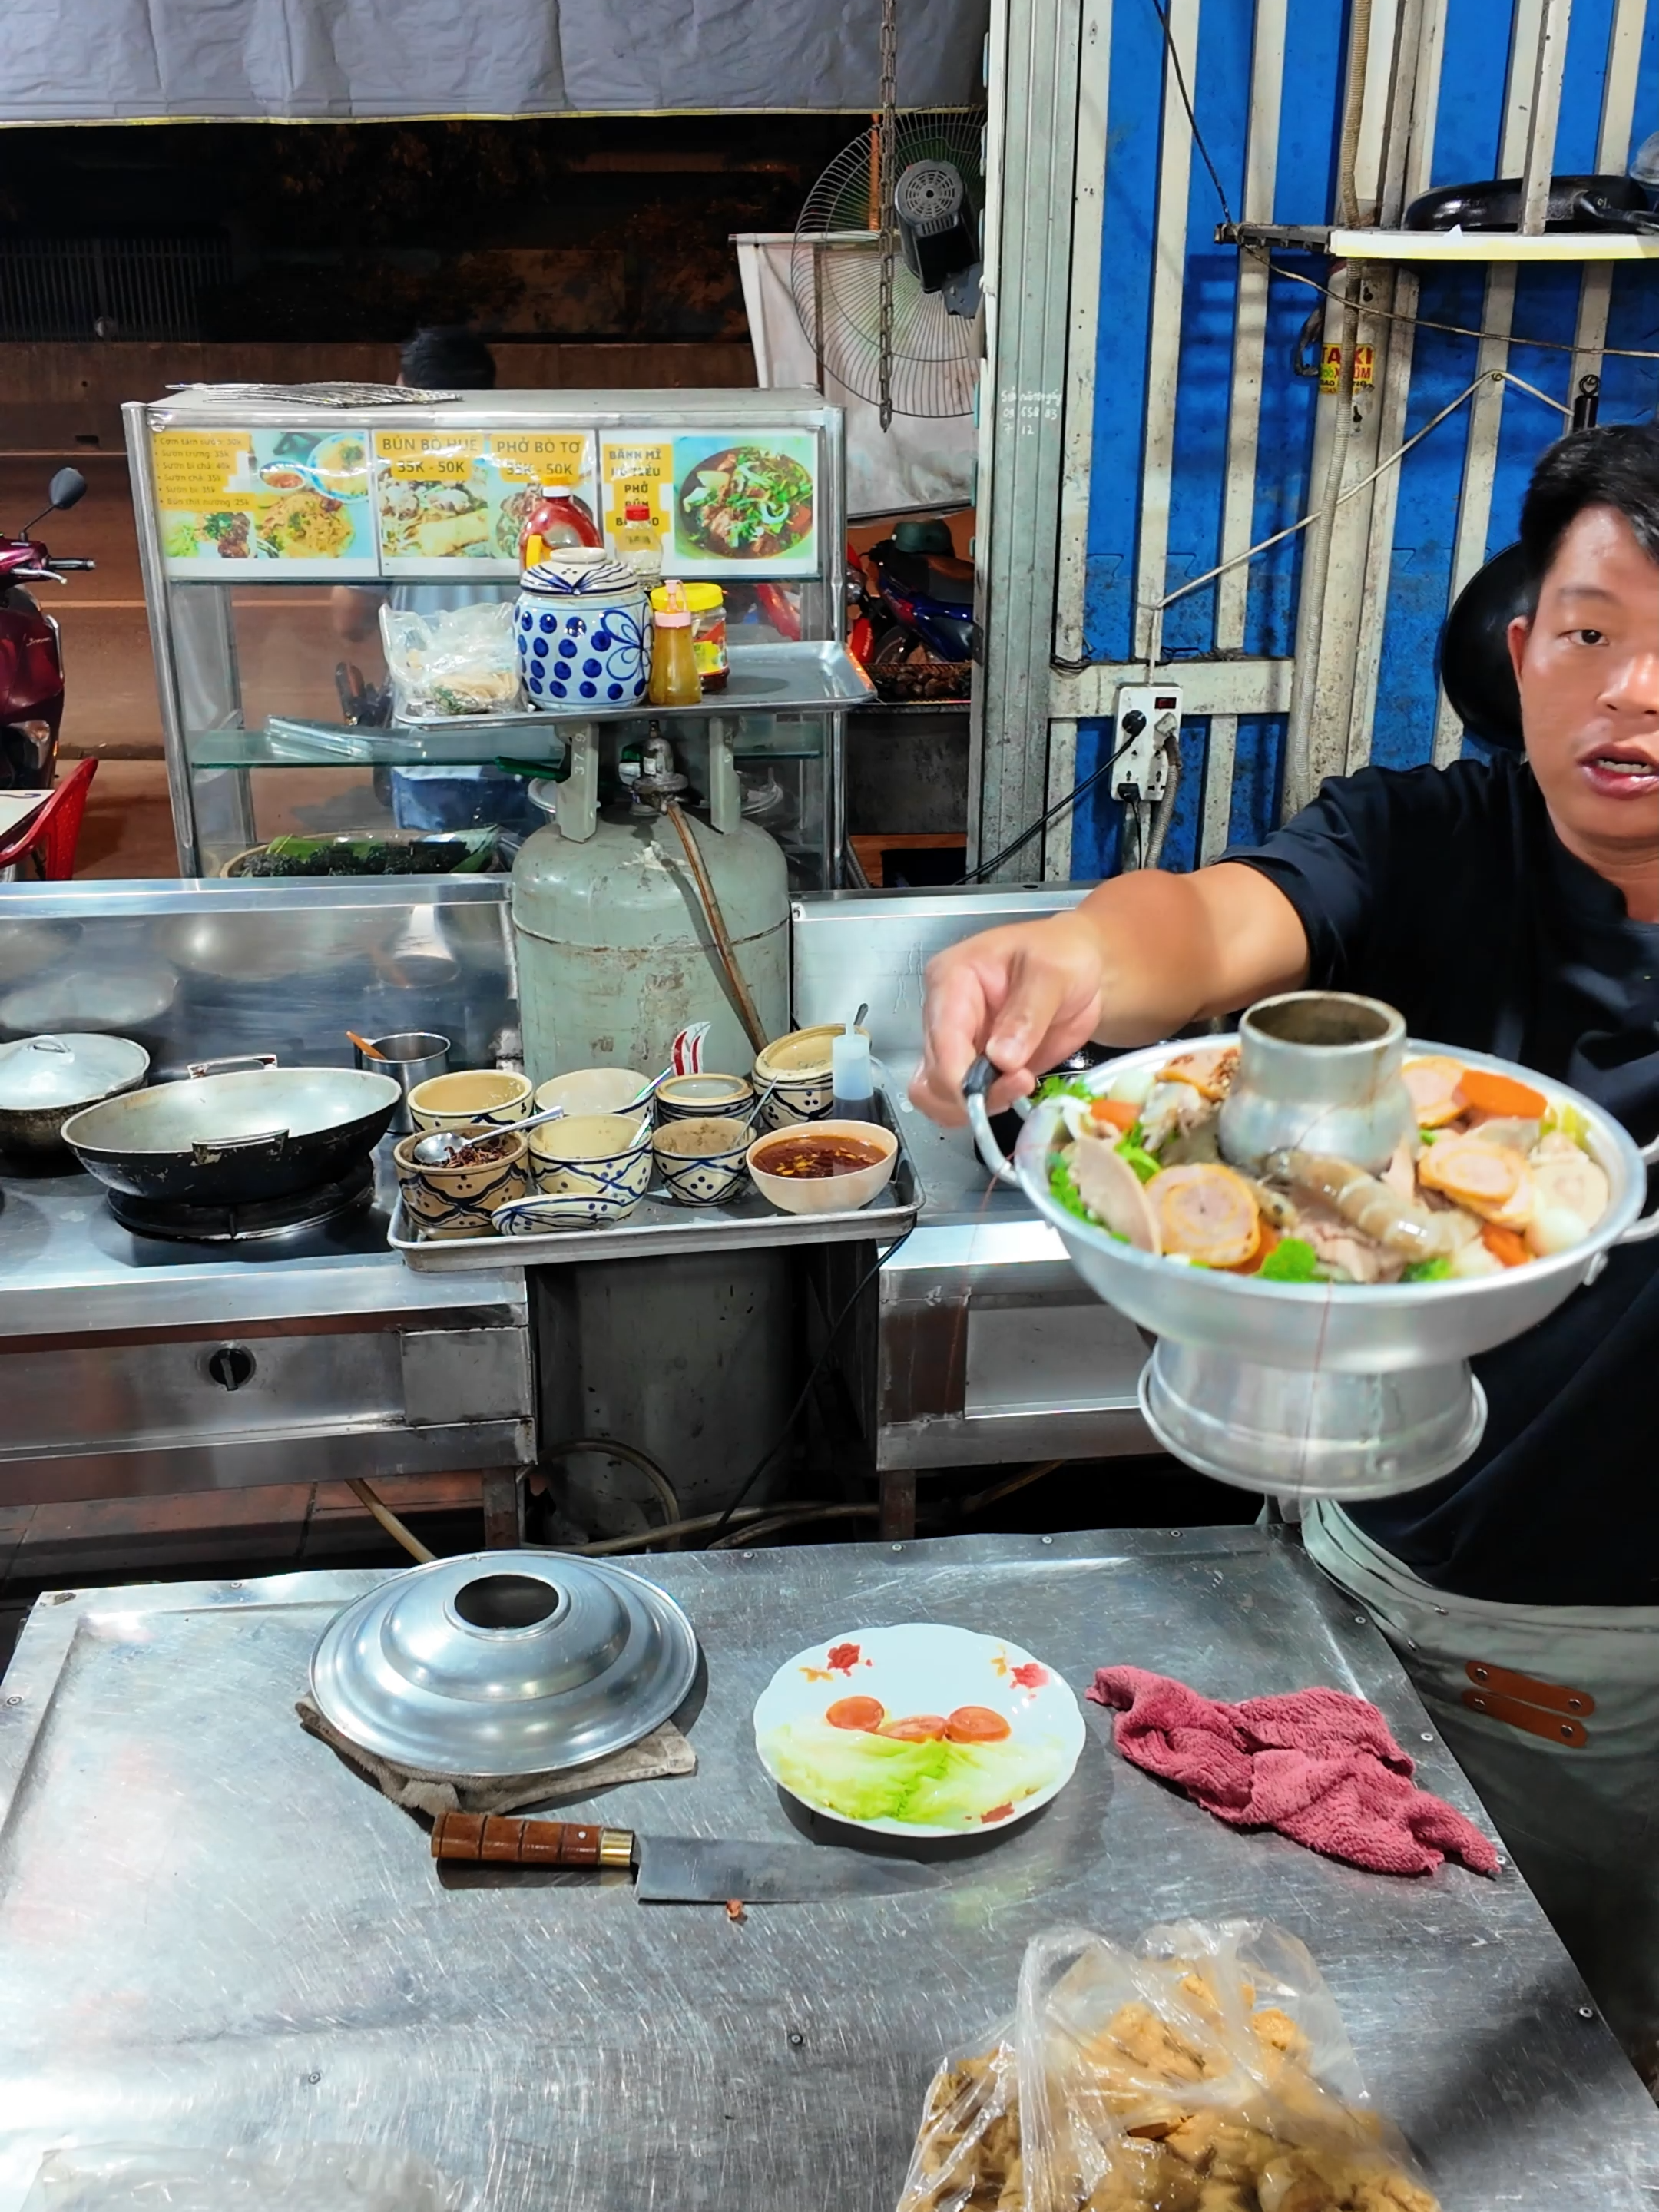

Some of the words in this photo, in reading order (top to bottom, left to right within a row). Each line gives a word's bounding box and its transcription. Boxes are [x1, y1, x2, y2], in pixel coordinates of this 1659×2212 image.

[382, 435, 416, 450] BÚN
[421, 435, 443, 450] BÒ
[497, 436, 530, 453] PHỞ
[535, 437, 555, 453] BÒ
[397, 460, 425, 473] 35K
[438, 460, 465, 473] 50K
[546, 463, 573, 475] 50K
[624, 481, 649, 493] PHỞ
